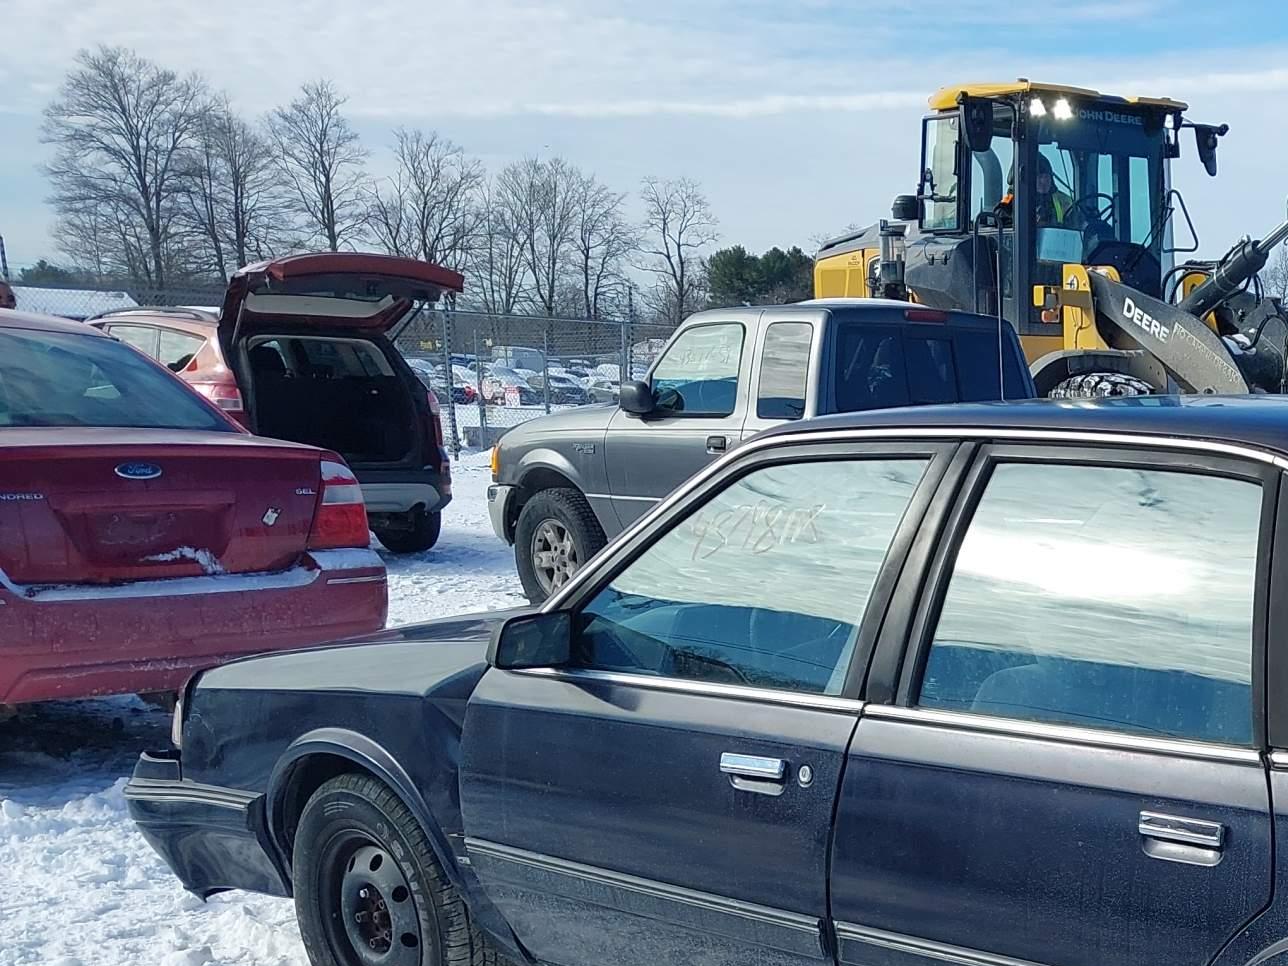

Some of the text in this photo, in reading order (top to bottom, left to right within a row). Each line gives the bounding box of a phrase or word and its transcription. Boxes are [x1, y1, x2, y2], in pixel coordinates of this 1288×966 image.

[1074, 107, 1144, 126] JOHN DEERE
[1122, 297, 1170, 344] DEERE
